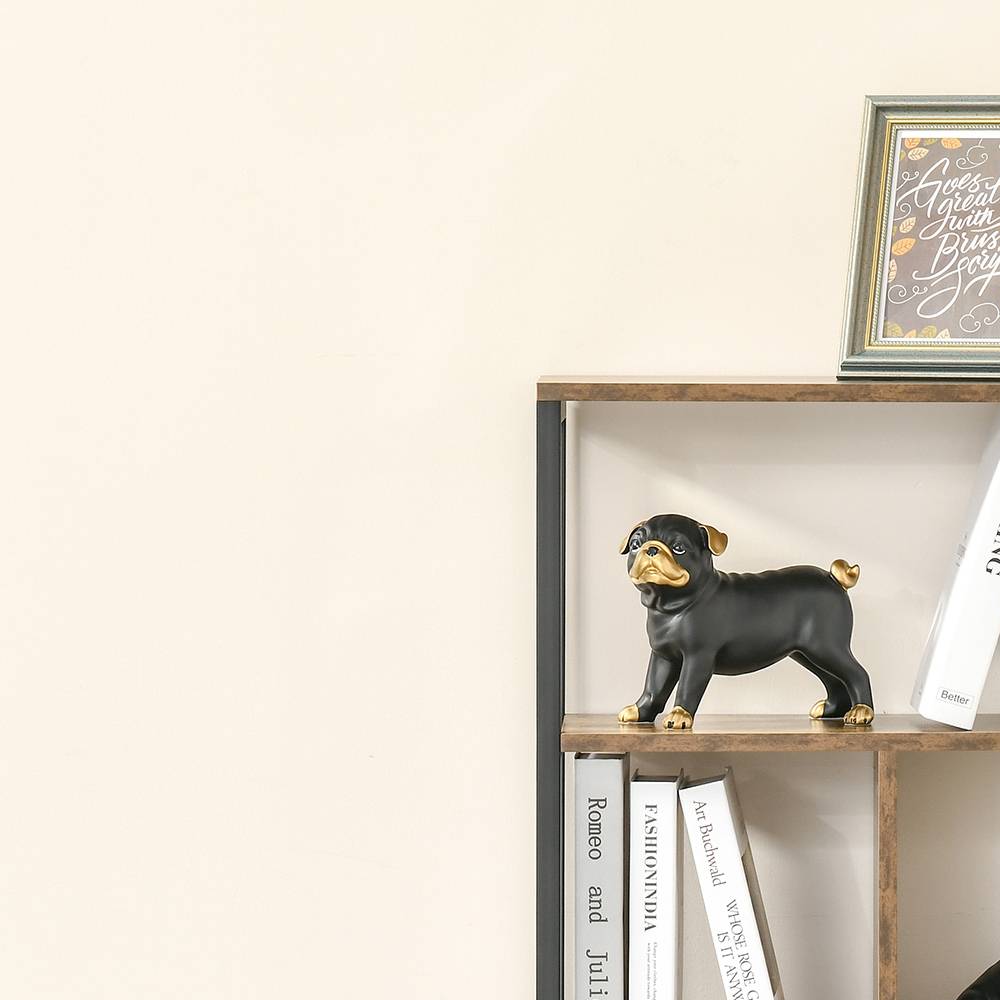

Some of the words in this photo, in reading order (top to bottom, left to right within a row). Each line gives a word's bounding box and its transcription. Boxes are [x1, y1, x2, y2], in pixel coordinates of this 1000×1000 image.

[896, 157, 994, 218] Goes
[940, 689, 970, 706] Better
[588, 797, 607, 861] Romeo
[692, 800, 706, 822] Art
[698, 823, 726, 887] Buchwald
[588, 886, 608, 924] and
[717, 931, 726, 944] IS
[720, 946, 734, 961] IT
[725, 899, 747, 951] WHOSE
[737, 952, 757, 987] ROSE
